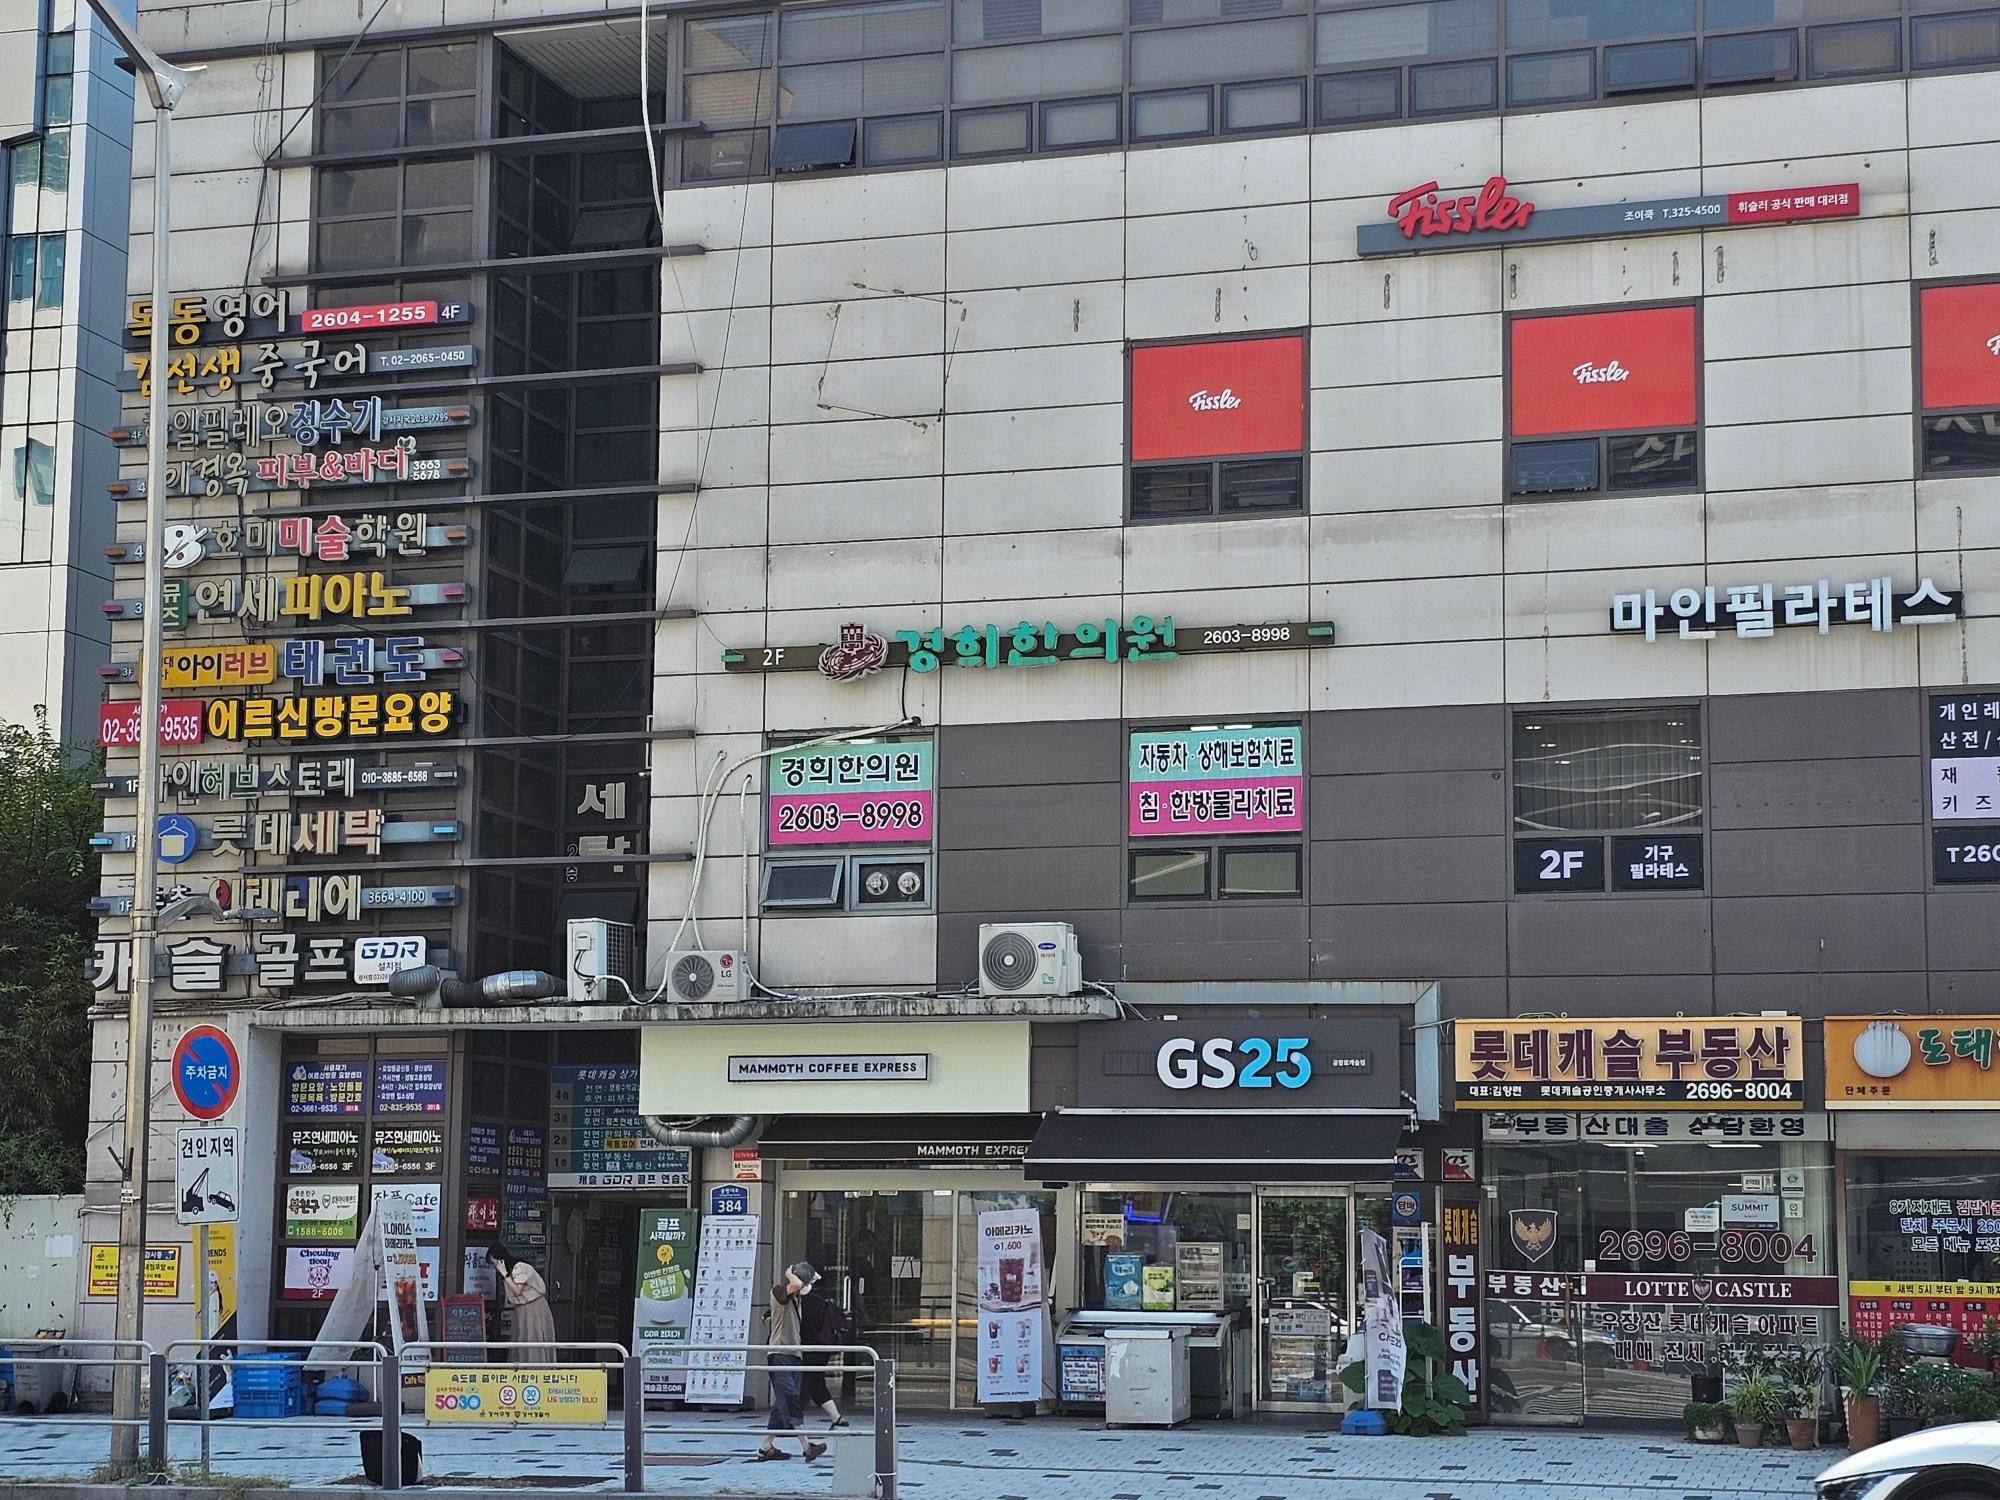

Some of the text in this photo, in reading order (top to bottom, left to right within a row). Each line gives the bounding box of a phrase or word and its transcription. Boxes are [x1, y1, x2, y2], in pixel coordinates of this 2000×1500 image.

[1387, 175, 1536, 240] Fissler
[1737, 192, 1848, 214] 휘슬러 공식 판매 대리점
[1623, 208, 1654, 222] 조이쿡
[311, 305, 460, 328] 2604-1255 4F
[1572, 360, 1630, 384] Fissler
[1188, 388, 1241, 411] Fissler
[413, 460, 440, 470] 3663
[1612, 576, 1957, 643] 마인필라테스
[895, 614, 1180, 673] 경희한의원
[1204, 627, 1290, 645] 2603-8998
[284, 636, 426, 685] 태권도
[762, 647, 785, 666] 2F
[103, 691, 452, 744] 02-36-9535 어르신방문요양
[361, 769, 427, 784] 010-3685-6568
[780, 750, 921, 789] 경희한의원
[778, 800, 923, 832] 2603-8998
[1645, 846, 1674, 860] 기구
[1539, 849, 1584, 880] 2F
[1630, 862, 1689, 880] 필라테스
[368, 890, 425, 904] 3664-4100
[361, 941, 419, 959] GDR
[739, 1062, 917, 1074] MAMMOTH COFFEE EXPRESS
[1157, 1037, 1312, 1089] GS25
[185, 1065, 228, 1080] 주차금지
[1686, 1083, 1792, 1100] 2696-8004
[292, 1131, 359, 1145] 뮤즈연세피아노
[375, 1130, 442, 1145] 뮤즈연세피아노
[181, 1136, 234, 1158] 견인지역
[917, 1144, 1029, 1156] MAMMOTH EXPRE
[342, 1163, 354, 1171] 3F
[424, 1163, 436, 1171] 3F
[602, 1174, 633, 1184] GDR
[405, 1193, 438, 1206] Cafe
[718, 1200, 742, 1214] 384
[1731, 1203, 1770, 1212] SUMMIT
[657, 1217, 680, 1231] 골프
[985, 1224, 1033, 1238] 아메리카노
[1900, 1217, 1927, 1234] 단체
[1932, 1217, 1972, 1234] 주문시
[1001, 1241, 1022, 1251] 1,600
[1599, 1230, 1817, 1263] 2696-8004
[1911, 1236, 1939, 1252] 모든
[1943, 1236, 1971, 1253] 메뉴
[312, 1289, 324, 1298] 2F
[1625, 1281, 1792, 1298] LOTTE CASTLE
[1918, 1285, 1932, 1294] 5시
[1936, 1285, 1952, 1294] 부터
[1969, 1286, 1983, 1295] 9시
[1601, 1312, 1662, 1333] 우장산
[1758, 1314, 1819, 1336] 아파트
[451, 1374, 477, 1383] 속도를
[512, 1374, 539, 1383] 사람이
[543, 1374, 578, 1384] 보입니다
[435, 1394, 481, 1410] 5030
